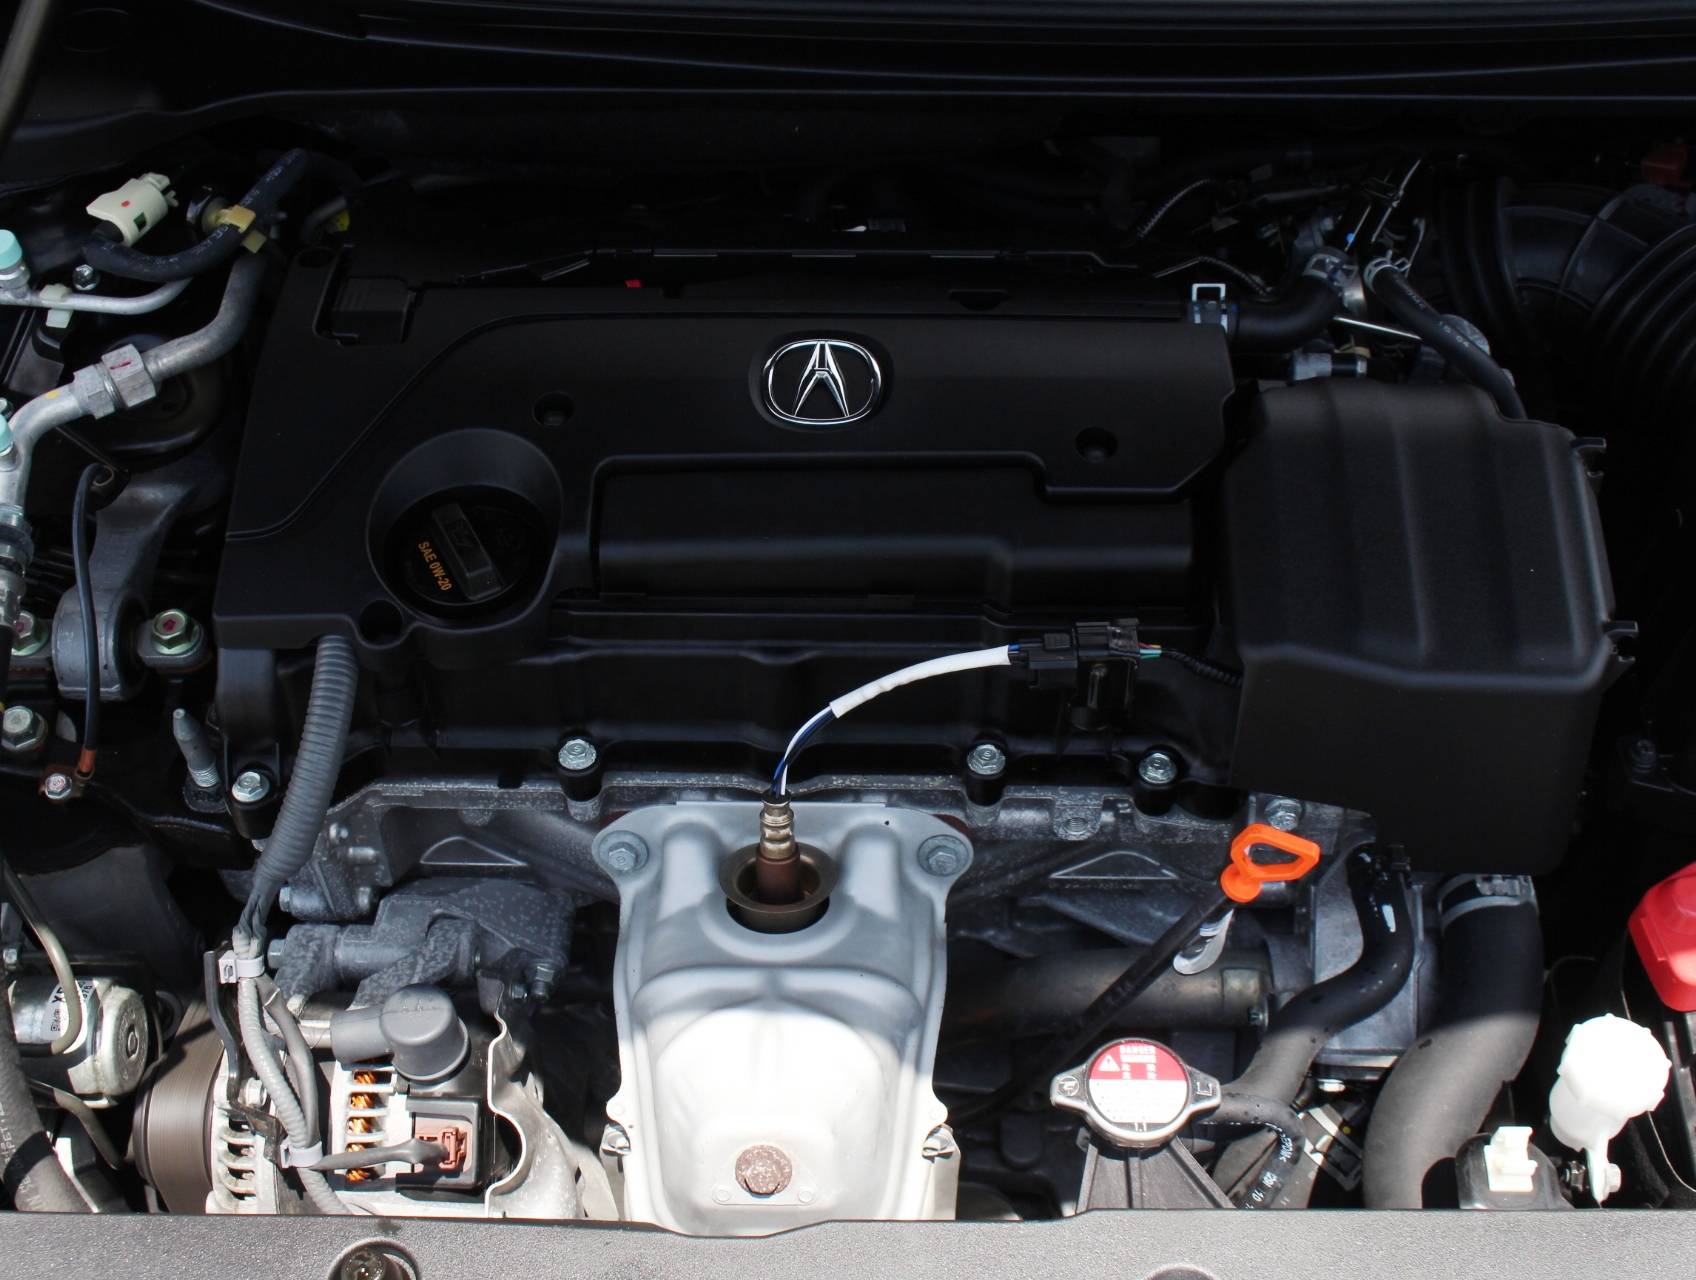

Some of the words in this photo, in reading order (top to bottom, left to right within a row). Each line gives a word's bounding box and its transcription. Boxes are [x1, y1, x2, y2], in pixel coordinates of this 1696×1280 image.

[417, 541, 437, 563] SAE
[429, 561, 453, 591] 0W-20
[1119, 1044, 1156, 1055] DANGER
